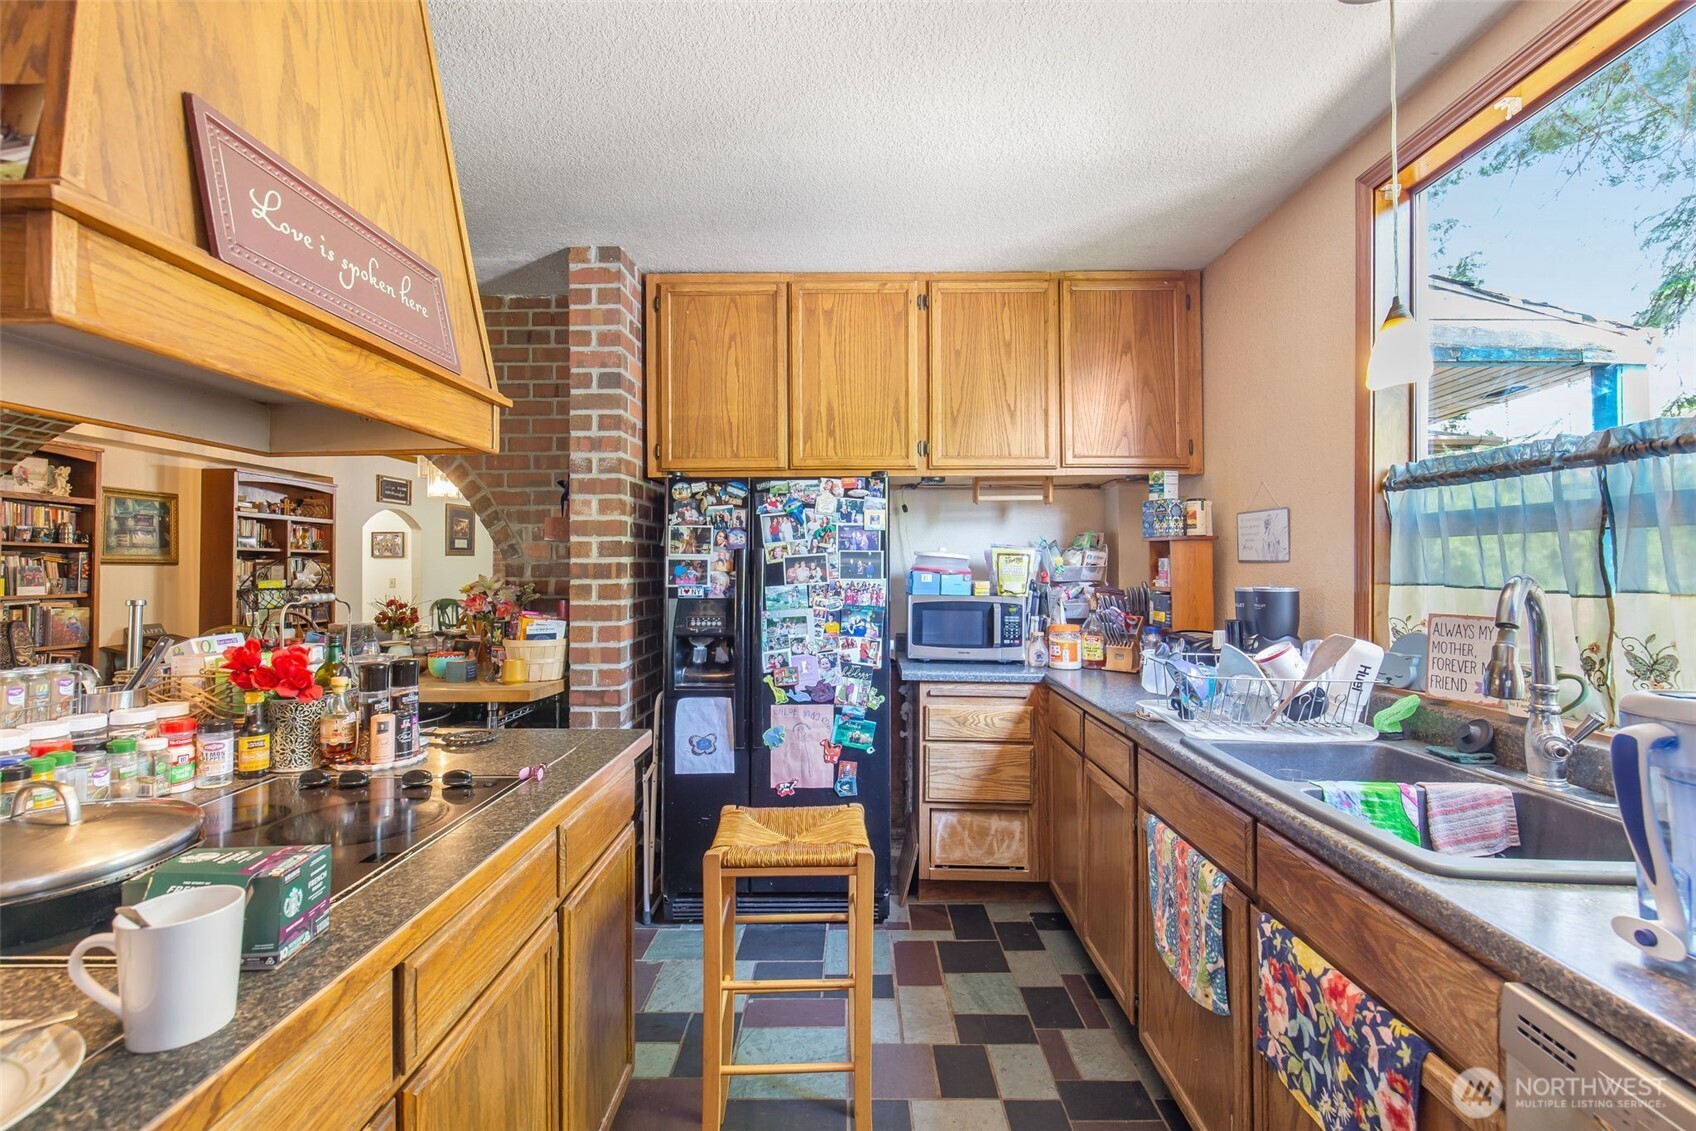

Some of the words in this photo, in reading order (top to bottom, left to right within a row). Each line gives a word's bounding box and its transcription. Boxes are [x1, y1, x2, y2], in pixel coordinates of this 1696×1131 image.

[249, 188, 313, 249] Love
[320, 235, 335, 261] is
[339, 257, 397, 298] spoken
[400, 276, 429, 318] here
[1432, 622, 1475, 639] ALWAYS
[1479, 625, 1495, 640] MY
[1432, 640, 1477, 658] MOTHER,
[1432, 656, 1477, 675] FOREVER
[1352, 664, 1372, 692] Huel
[1430, 674, 1468, 692] FRIEND
